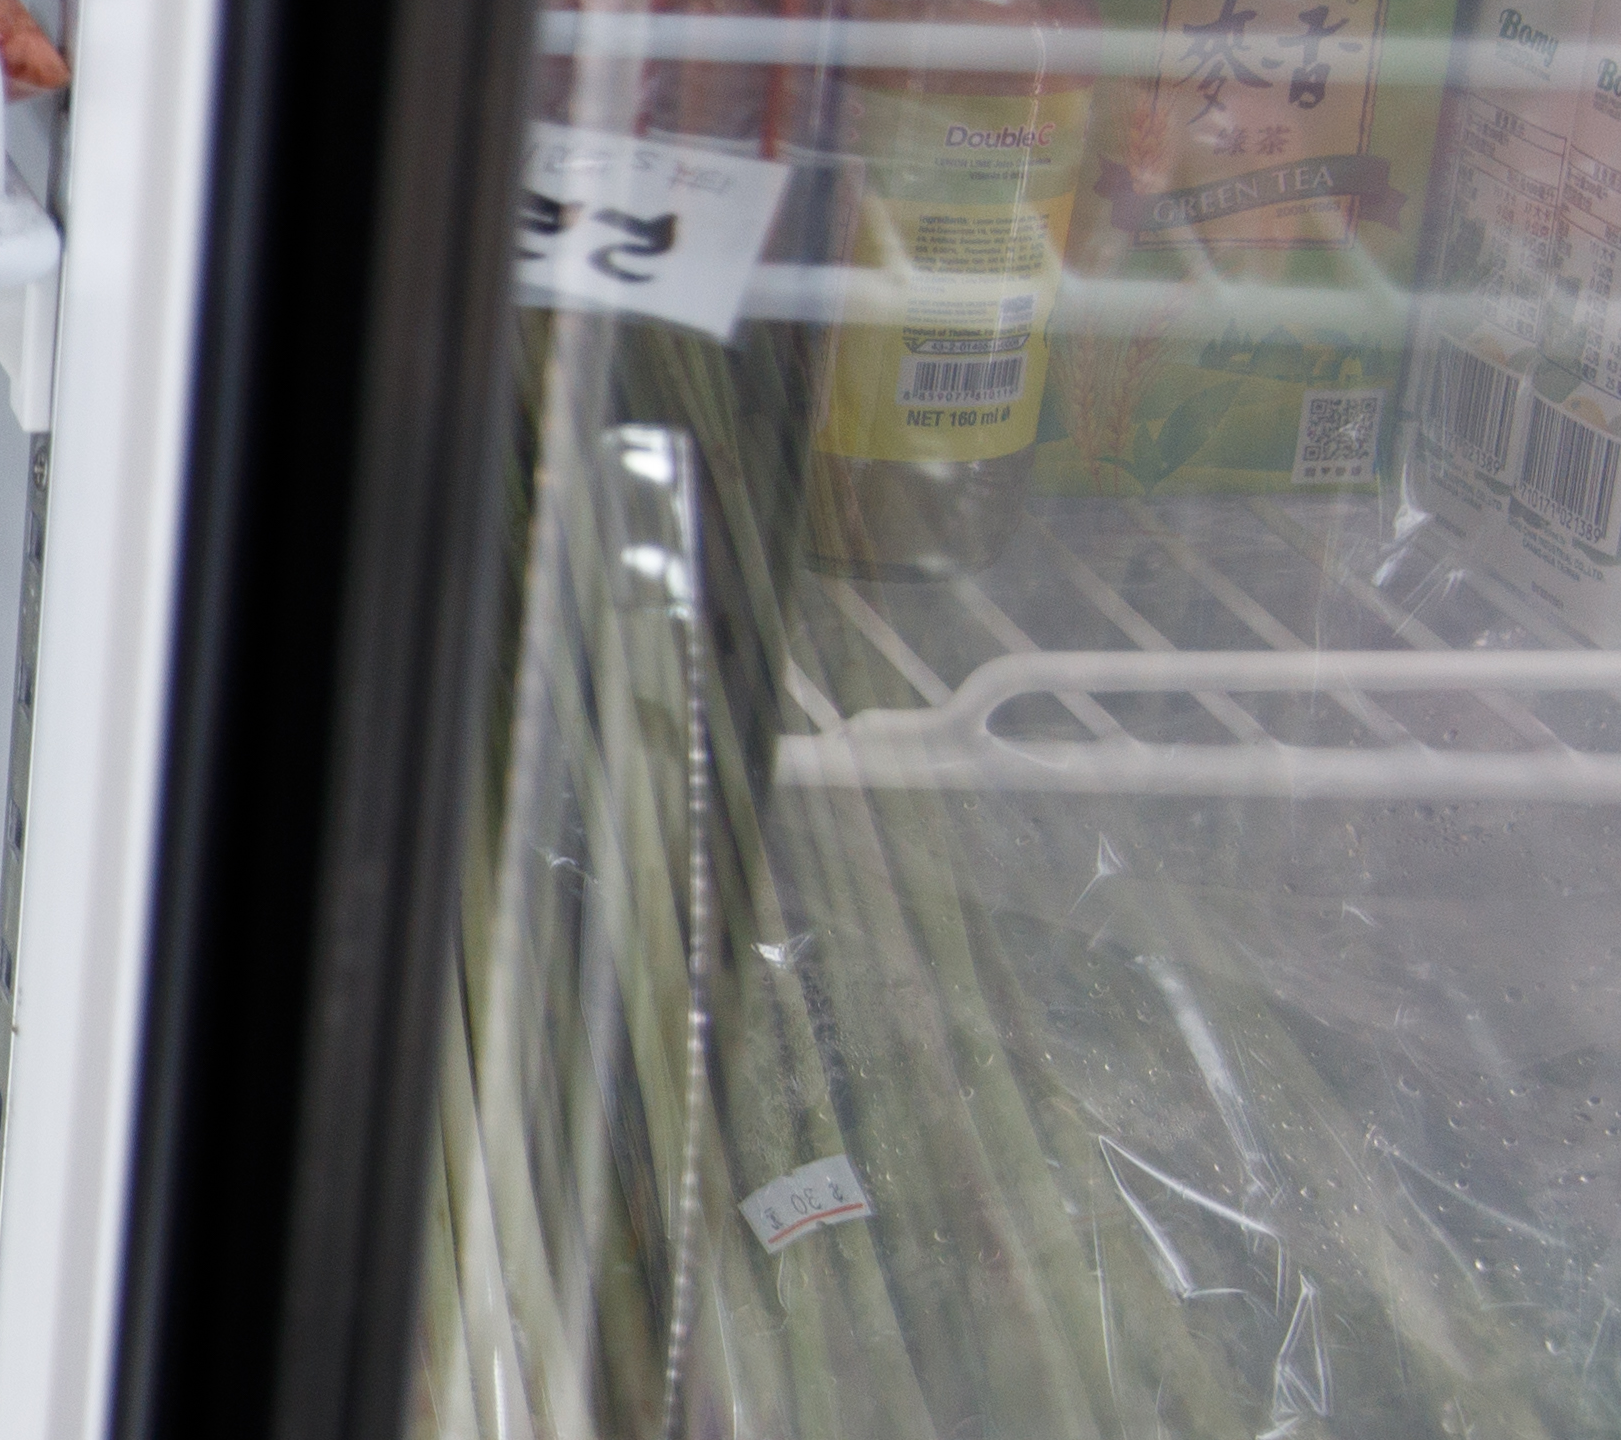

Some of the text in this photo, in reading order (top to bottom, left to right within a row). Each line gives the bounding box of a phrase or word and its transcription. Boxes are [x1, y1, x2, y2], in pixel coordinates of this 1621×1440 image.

[1499, 8, 1559, 68] Bomy
[1597, 58, 1621, 97] Bo
[1152, 177, 1260, 224] GREEN
[1271, 164, 1334, 194] TEA
[906, 409, 944, 427] NET
[949, 410, 977, 427] 160
[1519, 481, 1557, 519] 710171
[1559, 507, 1603, 544] 021389
